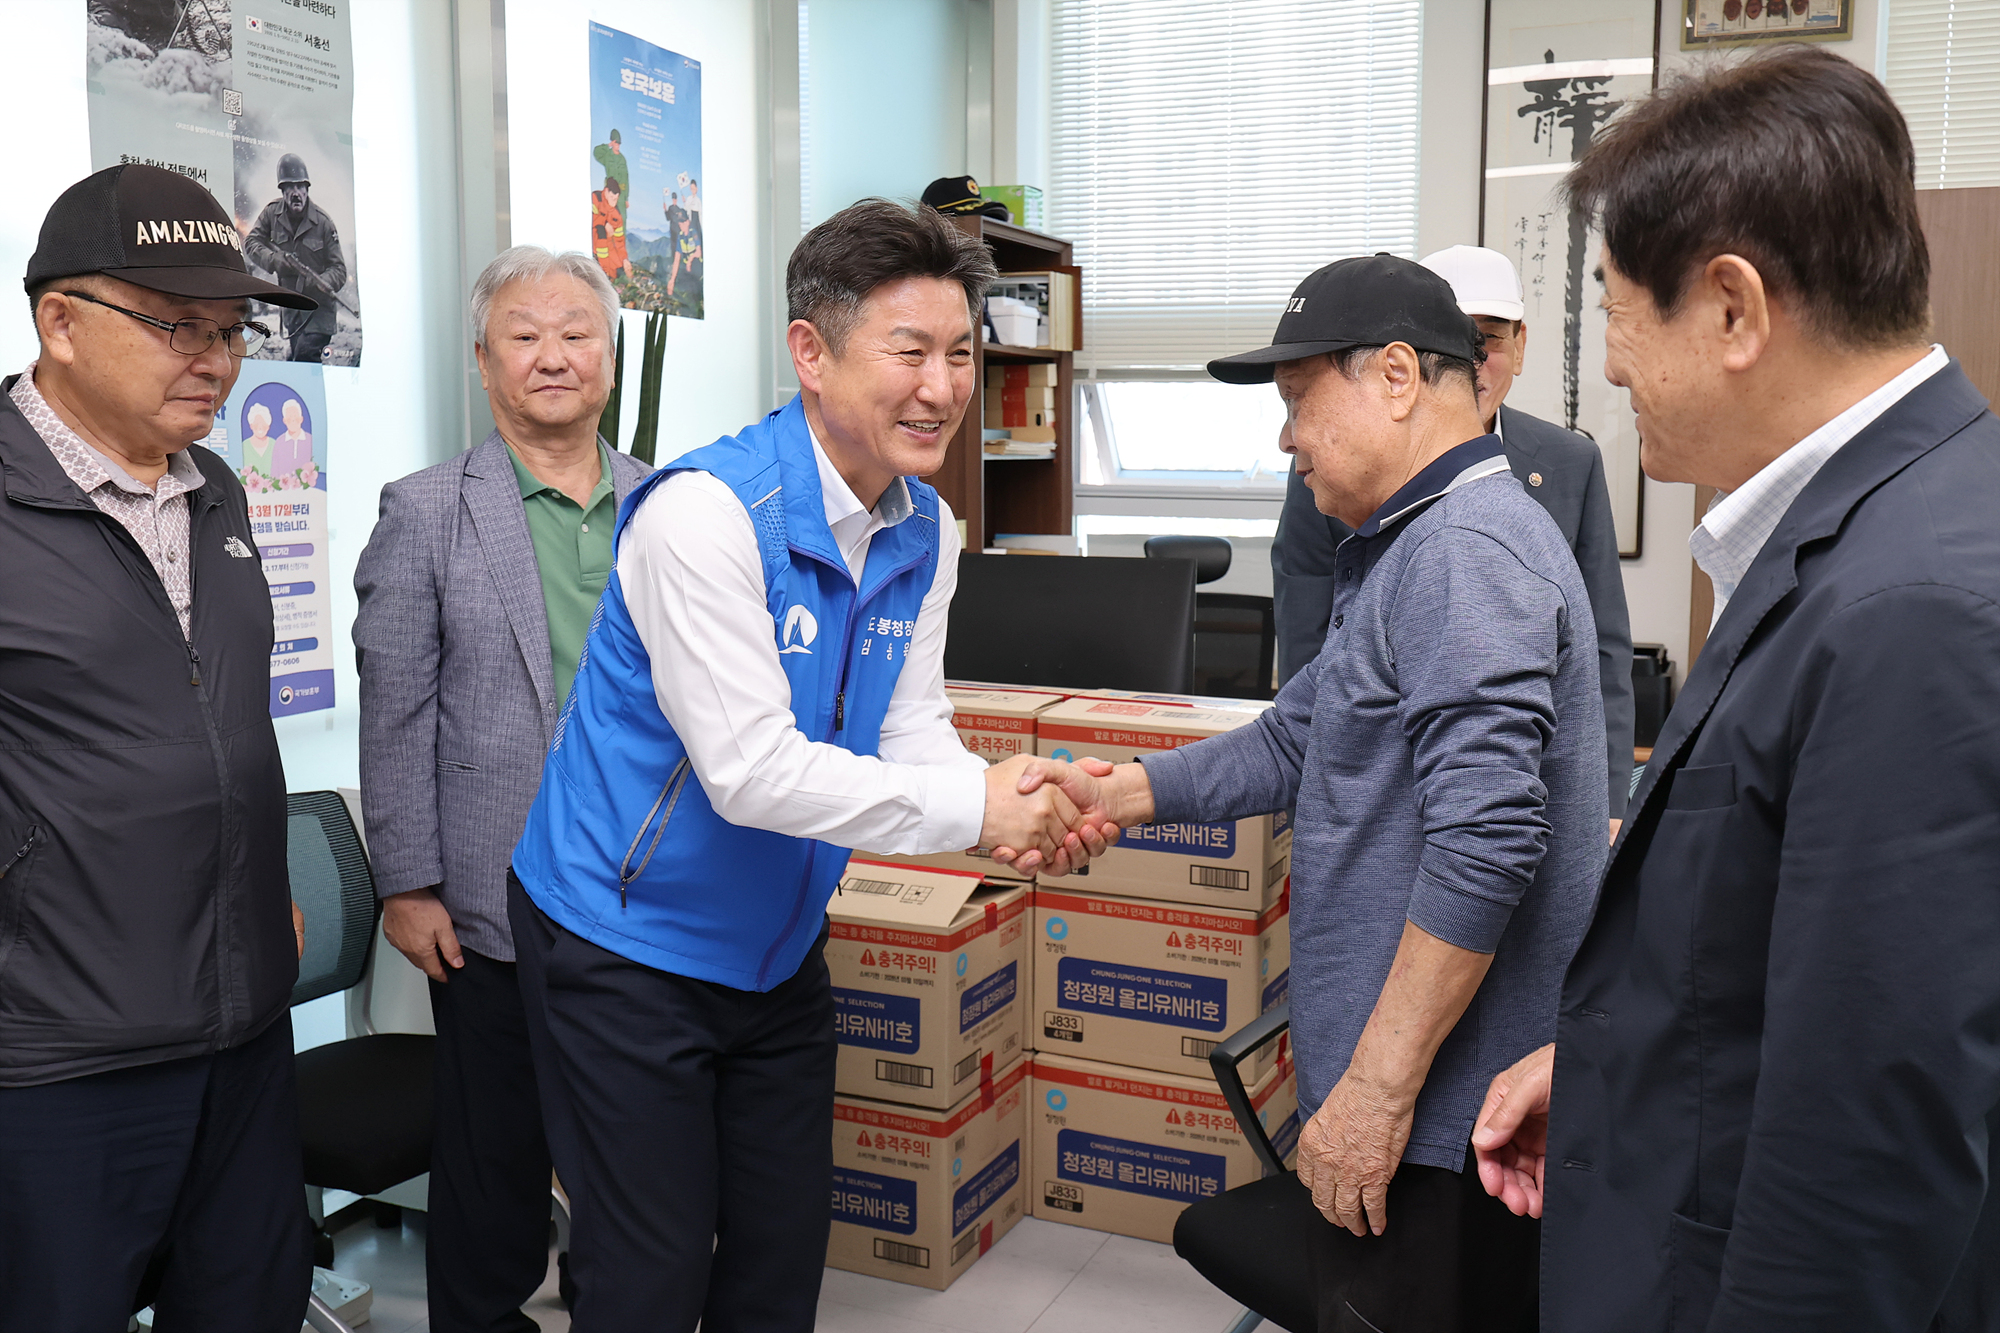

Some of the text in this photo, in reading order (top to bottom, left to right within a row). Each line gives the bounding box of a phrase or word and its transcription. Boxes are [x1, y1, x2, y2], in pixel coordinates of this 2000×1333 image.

[255, 504, 272, 518] 3월
[274, 503, 310, 517] 17일부터
[275, 520, 310, 533] 받습니다.
[968, 735, 1022, 755] 충격주의!
[830, 925, 847, 937] 지는
[1184, 933, 1242, 956] 충격주의!
[878, 950, 936, 974] 충격주의!
[1154, 977, 1192, 990] SELECTION
[847, 998, 885, 1010] SELECTION
[1063, 979, 1220, 1023] 청정원 올리유NH1호
[1049, 1014, 1078, 1029] J833
[874, 1132, 931, 1158] 충격주의!
[1063, 1150, 1218, 1198] 청정원 올리유NH1호
[1049, 1185, 1078, 1200] J833
